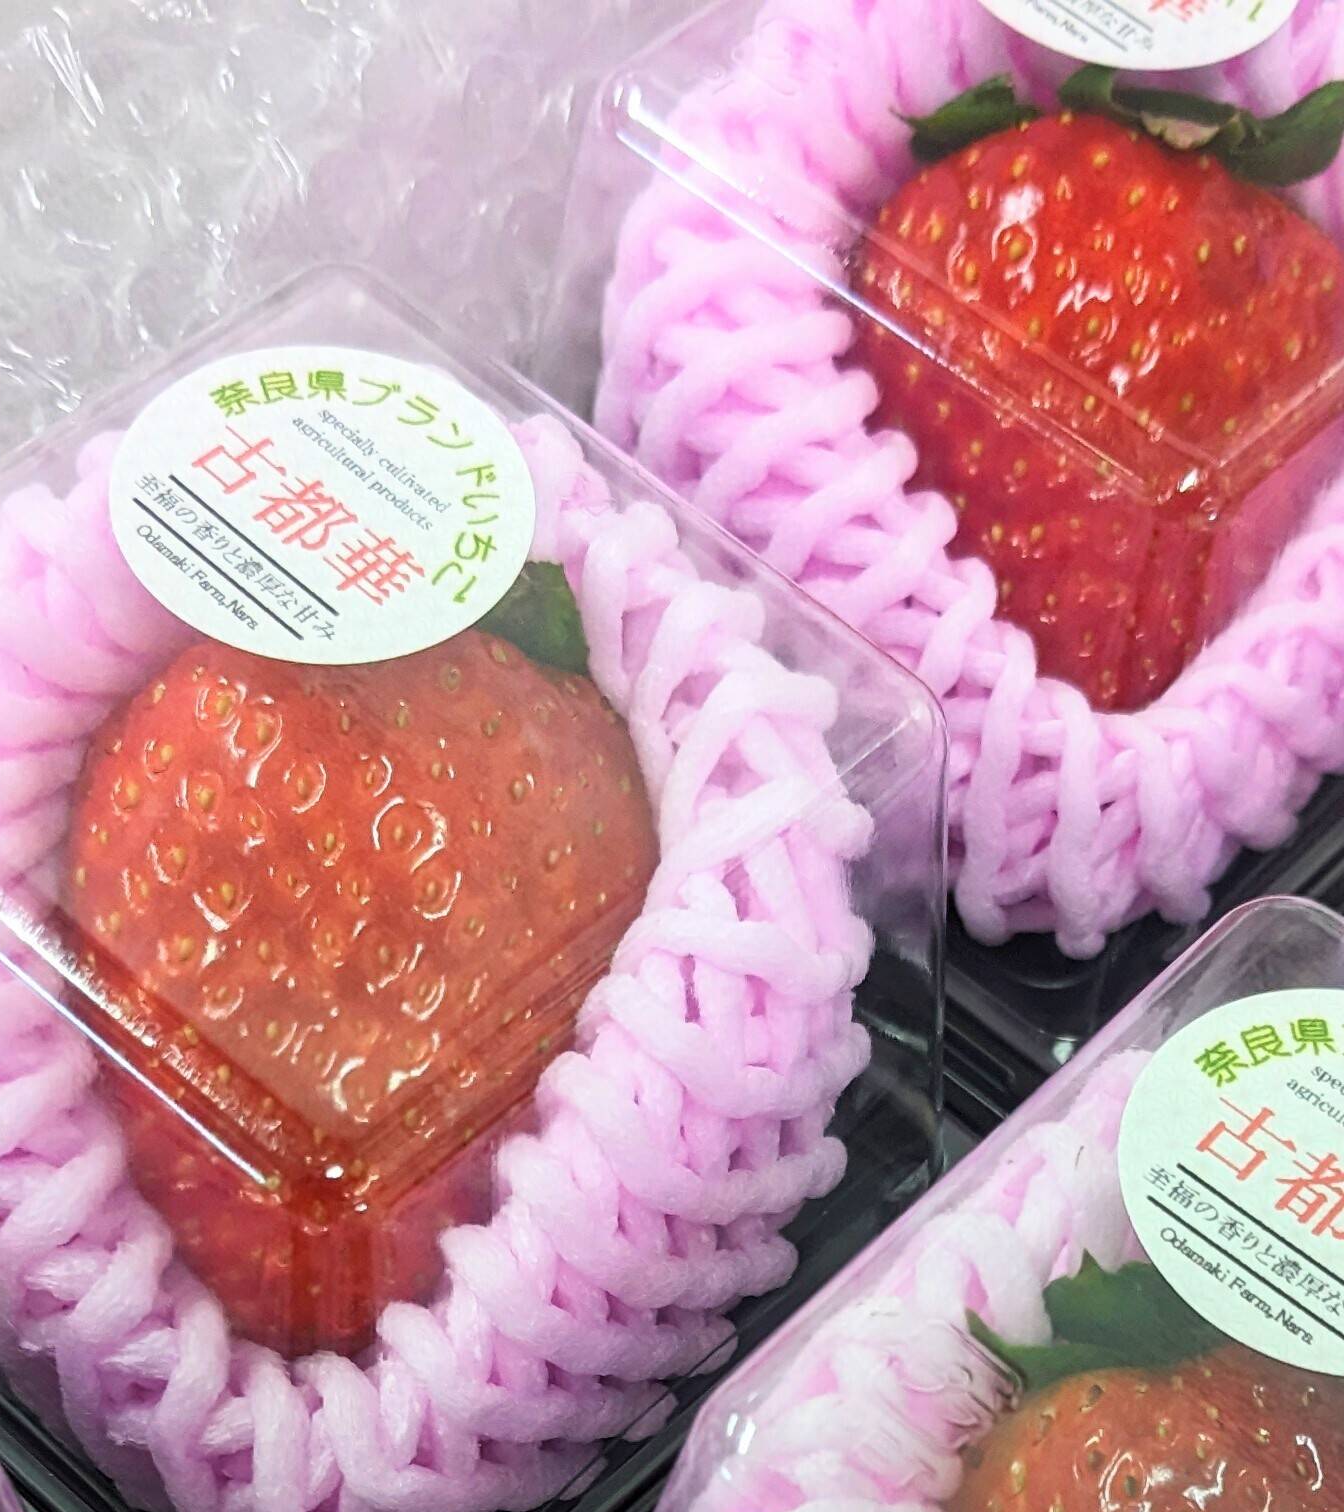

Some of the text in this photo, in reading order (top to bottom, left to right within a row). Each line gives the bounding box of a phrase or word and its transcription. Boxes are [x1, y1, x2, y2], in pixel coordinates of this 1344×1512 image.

[191, 426, 425, 605] 古都華
[209, 370, 500, 604] 奈良県ブランドいちご
[292, 416, 434, 531] agricultural products
[317, 409, 450, 514] specially cultivated
[135, 472, 338, 640] 至福の香りと濃厚な甘み
[136, 524, 201, 574] Odamaki
[1160, 1226, 1230, 1283] Odamaki
